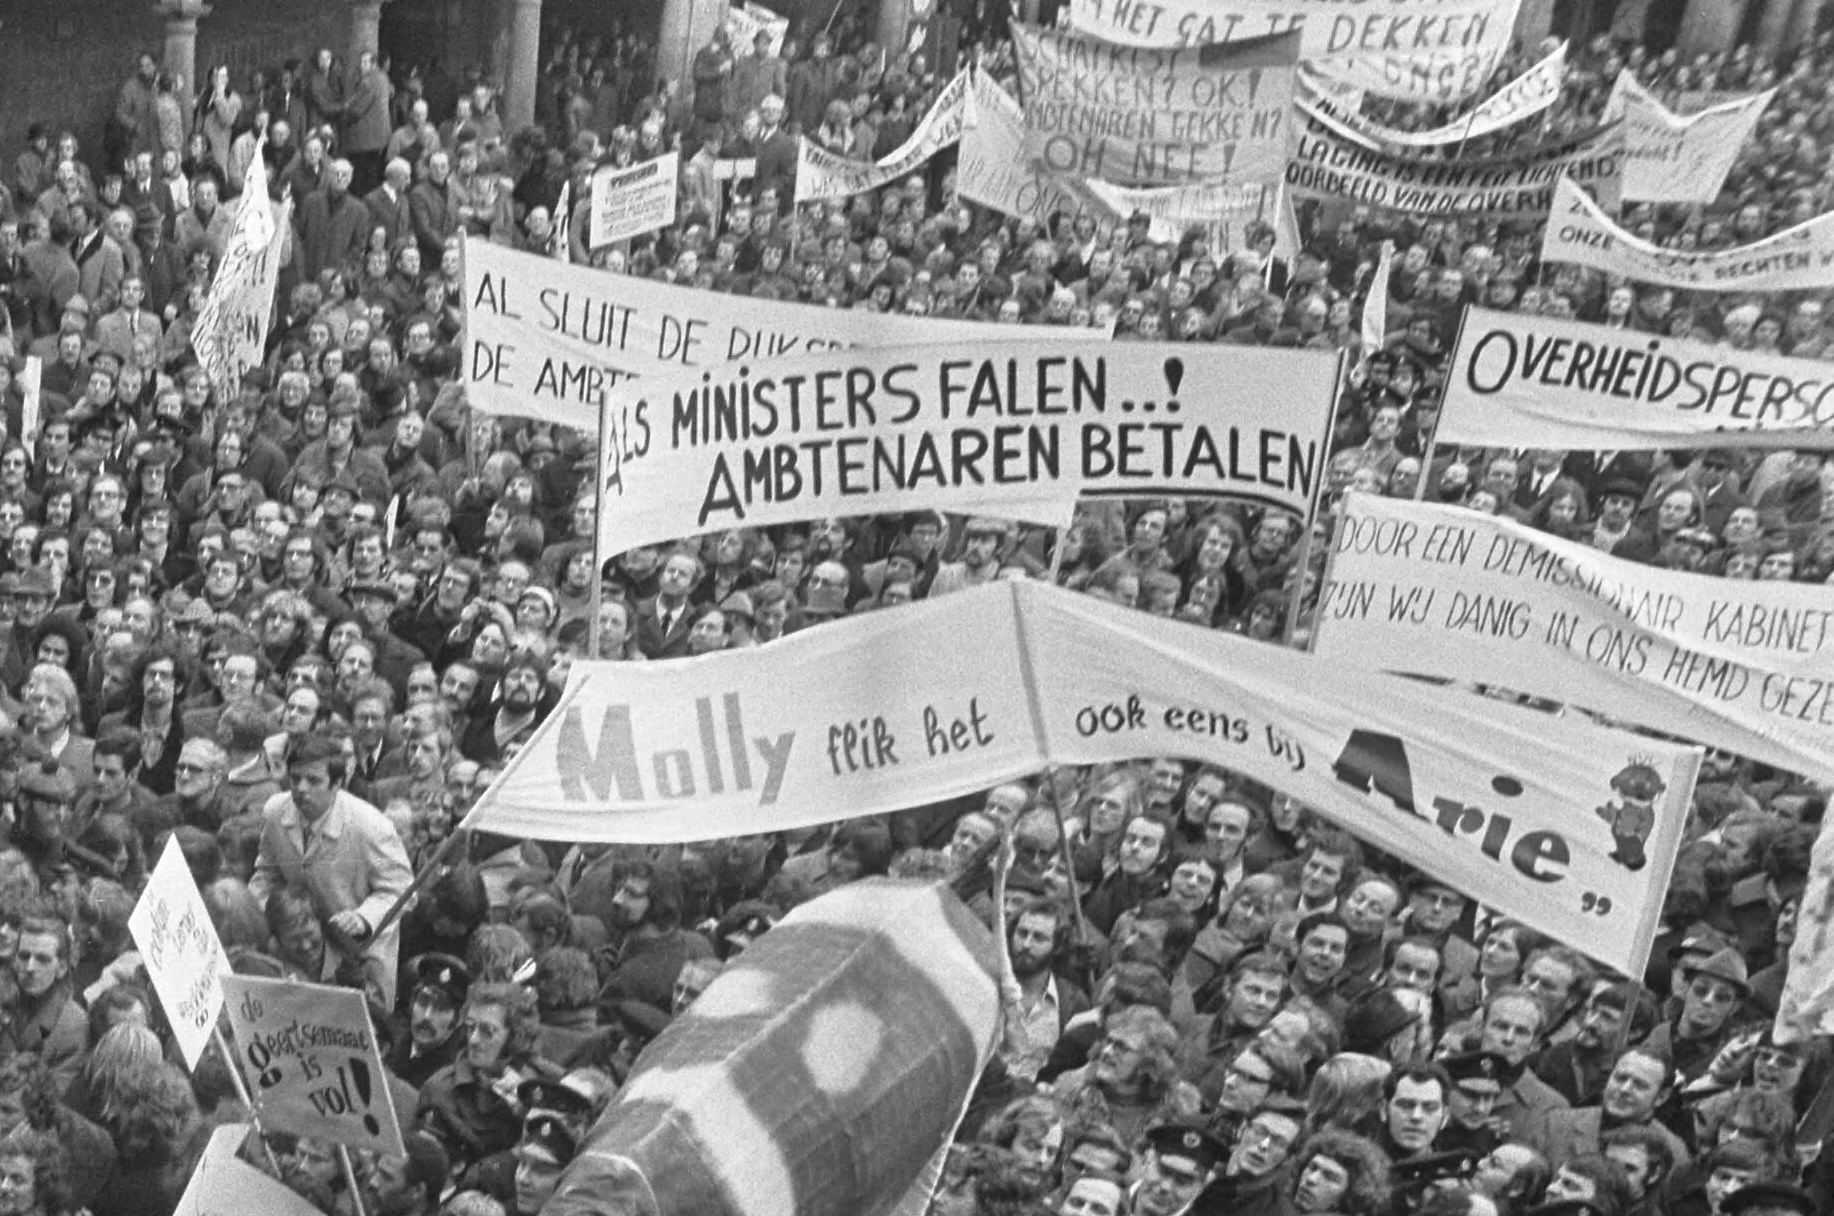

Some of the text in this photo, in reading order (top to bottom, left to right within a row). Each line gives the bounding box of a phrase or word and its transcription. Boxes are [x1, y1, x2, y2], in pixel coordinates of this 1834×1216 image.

[1327, 12, 1490, 52] DEKKEN
[1192, 70, 1263, 109] OK!
[1172, 110, 1283, 141] GEKKEN?
[1043, 134, 1236, 182] OH NEE!
[475, 272, 523, 321] AL
[539, 287, 641, 351] SLUIT
[658, 315, 709, 366] DE
[472, 340, 514, 388] DE
[697, 424, 1317, 526] AMBTENAREN BETALEN
[1338, 514, 1419, 558] DOOR
[1422, 523, 1476, 566] EEN
[1703, 596, 1832, 652] KABINET
[1388, 584, 1435, 624] WIJ
[1445, 588, 1532, 640] DANIG
[1545, 610, 1579, 646] IN
[1586, 624, 1653, 675] ONS
[1665, 645, 1749, 702] HEMD
[556, 692, 796, 806] Molly
[826, 715, 900, 776] flik
[923, 697, 995, 758] het
[1075, 693, 1146, 737] ook
[1163, 706, 1249, 744] eens
[296, 1051, 323, 1082] is
[307, 1056, 381, 1137] vol!
